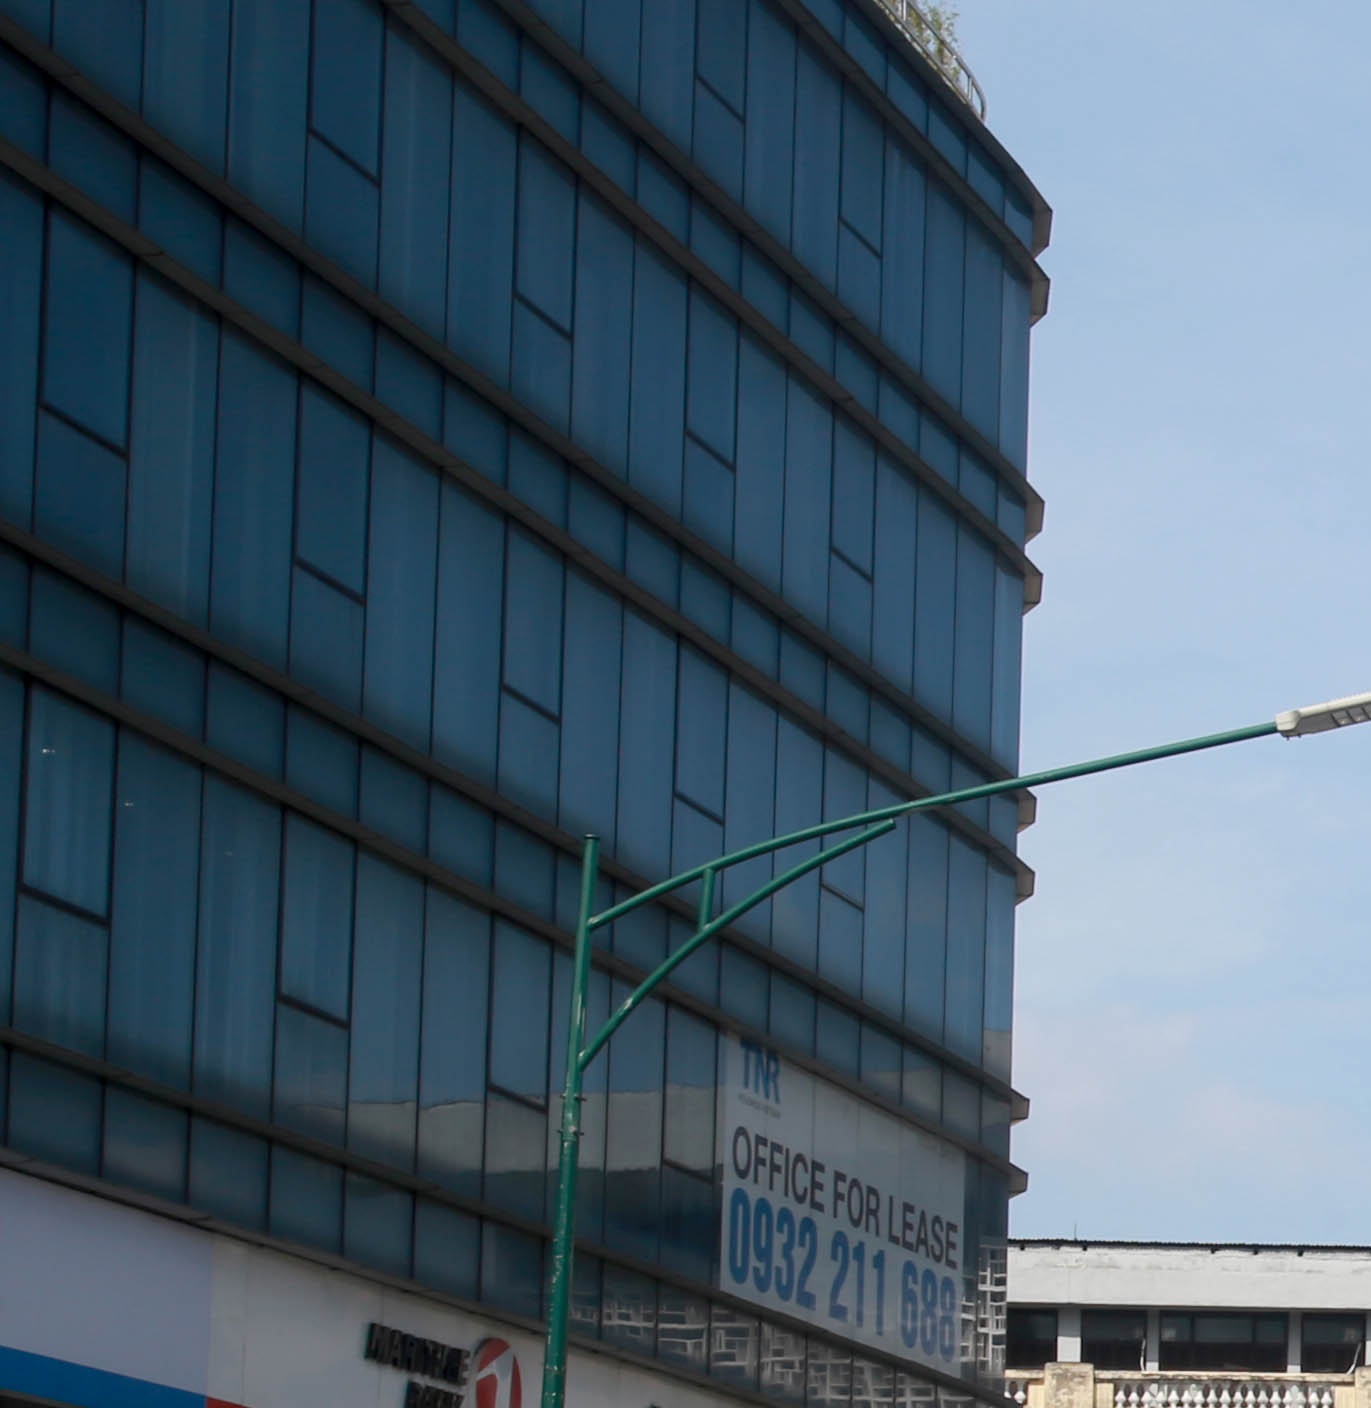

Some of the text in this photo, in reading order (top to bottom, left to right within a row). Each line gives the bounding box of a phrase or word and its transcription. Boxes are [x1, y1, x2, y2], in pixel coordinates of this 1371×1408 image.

[733, 1126, 958, 1269] OFFICE FOR LEASE
[729, 1188, 957, 1362] 0932 211 688
[365, 1322, 470, 1386] MARITIME
